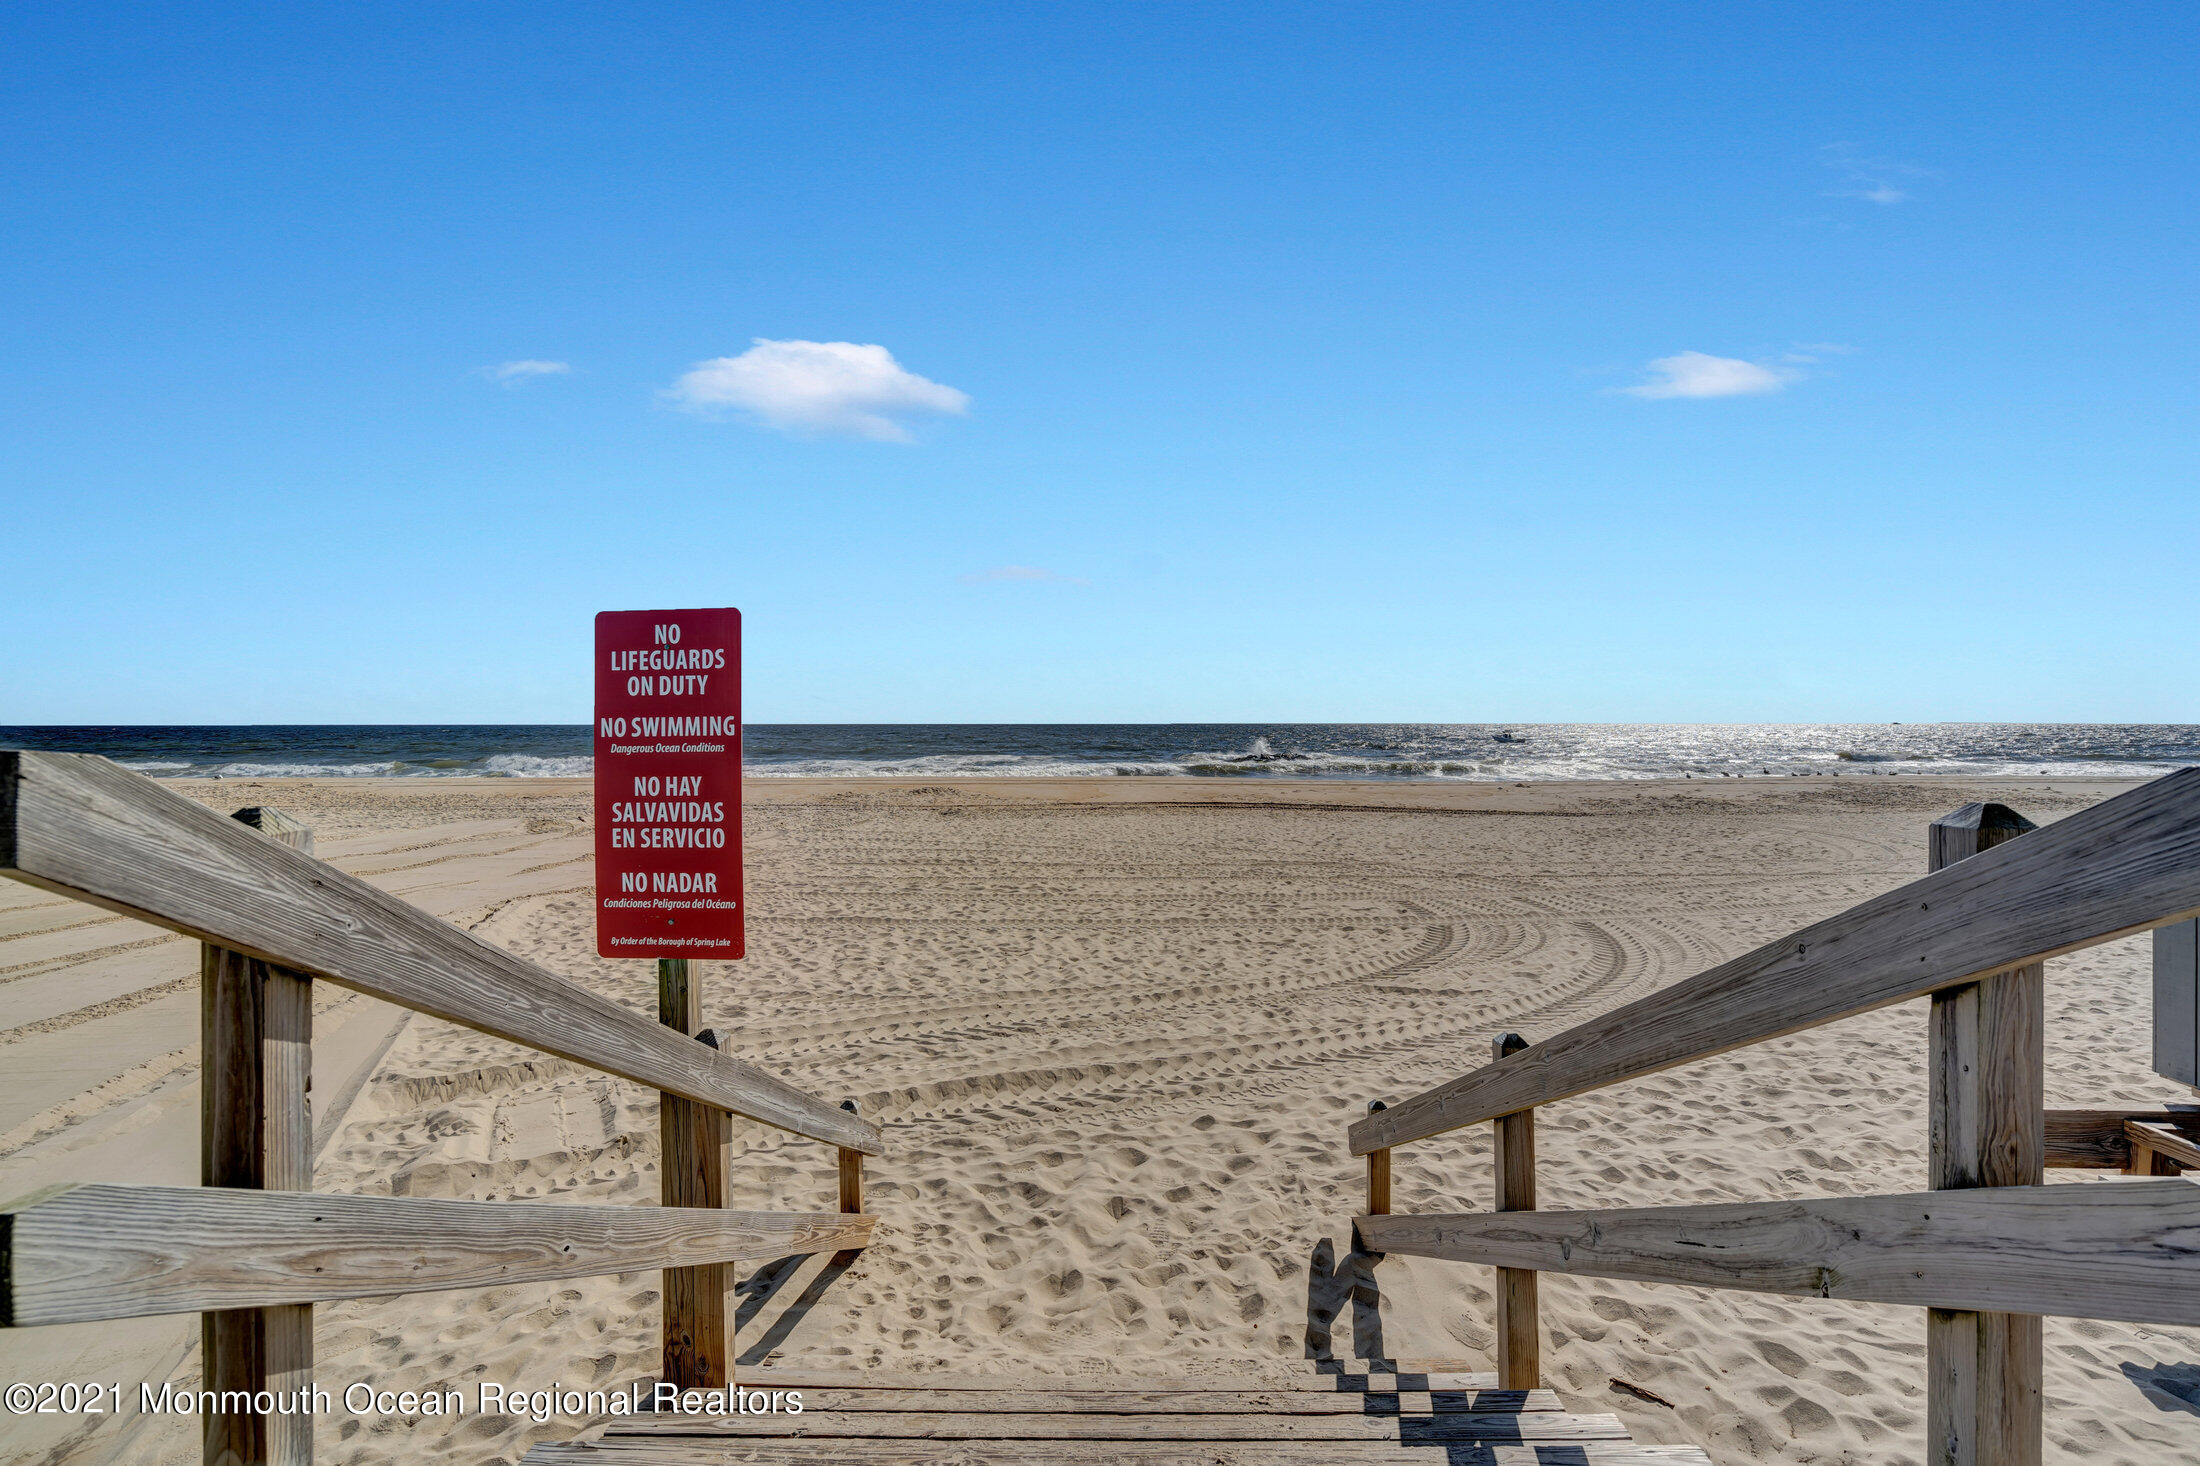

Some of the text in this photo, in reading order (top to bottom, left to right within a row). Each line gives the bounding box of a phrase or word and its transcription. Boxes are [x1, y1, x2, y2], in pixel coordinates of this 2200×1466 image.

[655, 624, 681, 644] NO
[611, 649, 725, 671] LIFEGUARDS
[627, 675, 708, 696] ON DUTY
[601, 716, 735, 737] NO SWIMMING
[611, 742, 725, 755] Dangerous Ocean Conditions
[634, 776, 702, 796] NO HAY
[612, 802, 725, 822] SALVAVIDAS
[612, 828, 725, 848] EN SERVICIO
[621, 872, 717, 893] NO NADAR
[603, 898, 736, 911] Condiciones Peligrosa del Océano
[611, 937, 731, 947] By Order of the Borough of Spring Lake
